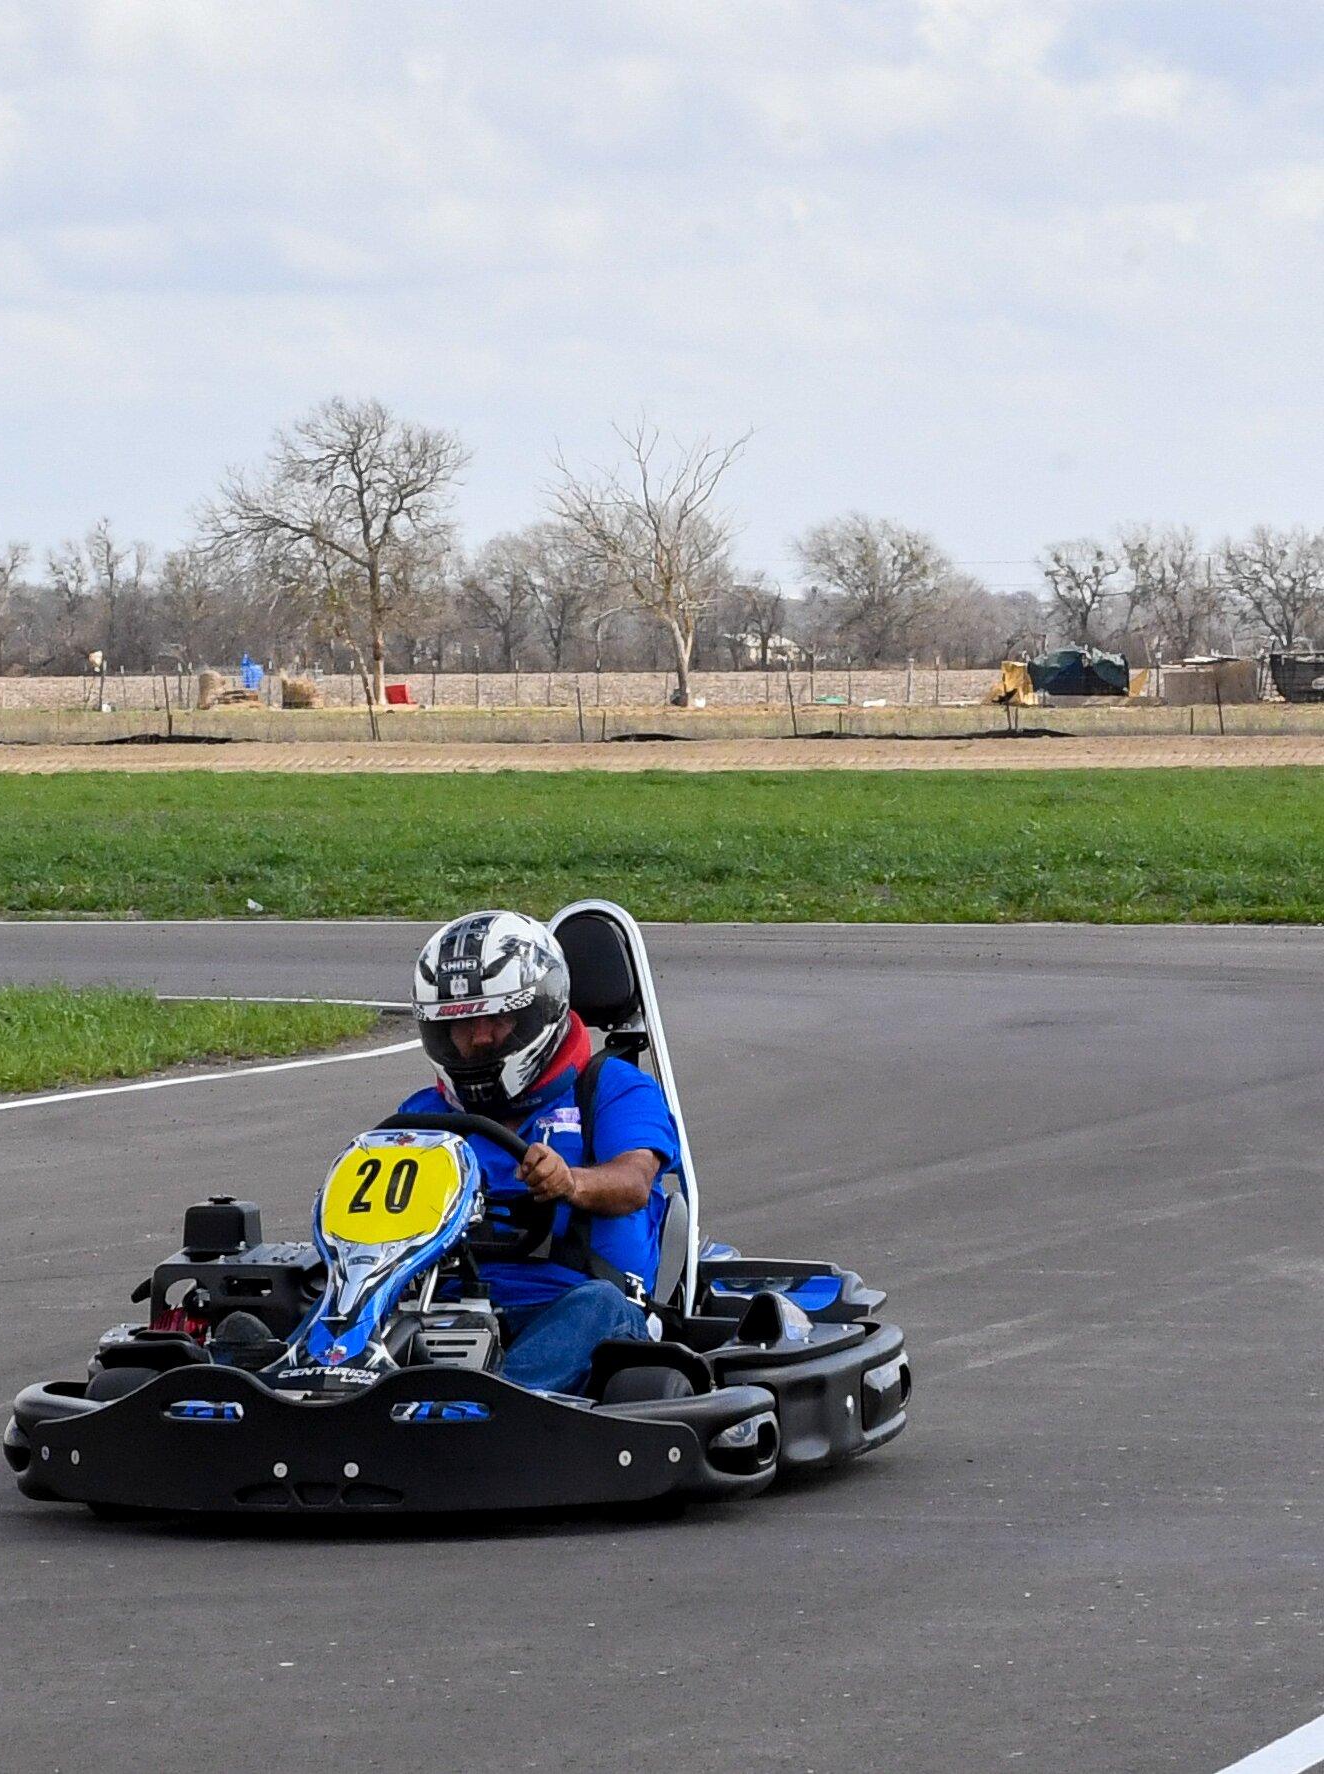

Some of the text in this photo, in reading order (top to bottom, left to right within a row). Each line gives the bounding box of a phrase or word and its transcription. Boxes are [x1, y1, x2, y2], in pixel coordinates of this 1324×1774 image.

[440, 959, 478, 972] SHOEI
[347, 1158, 419, 1215] 20
[277, 1366, 381, 1380] CENTURION
